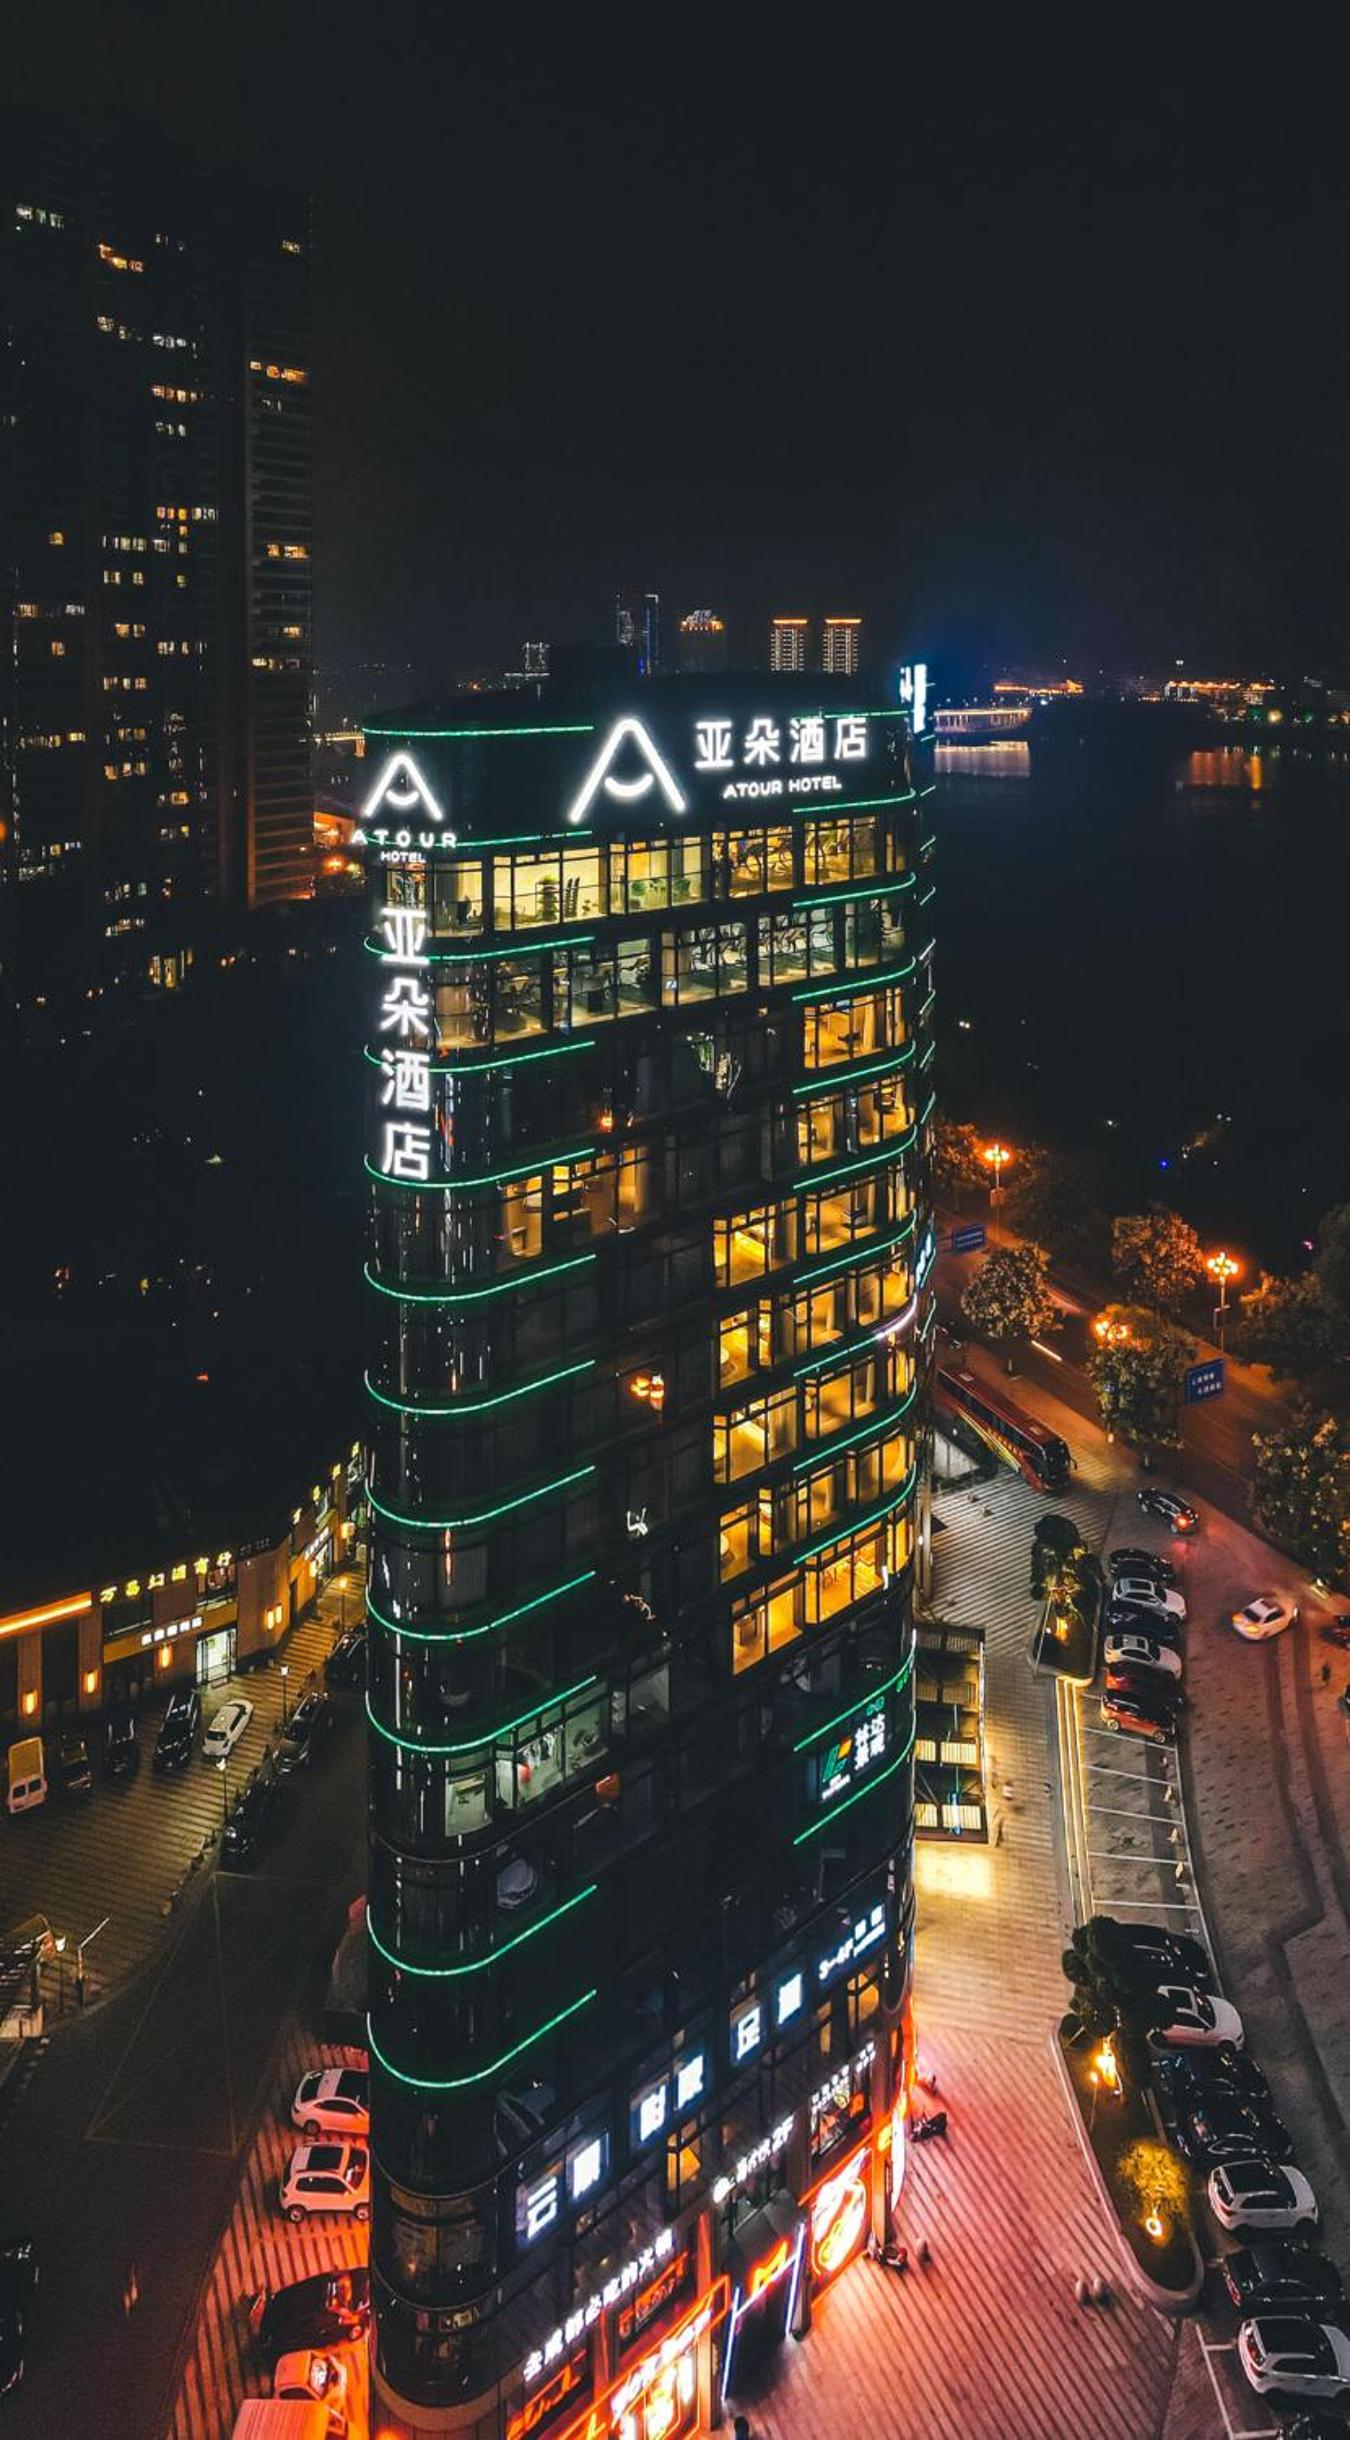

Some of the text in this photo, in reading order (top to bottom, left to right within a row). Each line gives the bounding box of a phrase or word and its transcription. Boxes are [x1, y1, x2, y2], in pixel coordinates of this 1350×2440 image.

[695, 716, 868, 772] 亚朵酒店
[723, 775, 843, 800] ATOUR HOTEL
[350, 829, 459, 849] ATOUR
[380, 850, 427, 864] HOTEL
[380, 906, 433, 1181] 亚朵酒店
